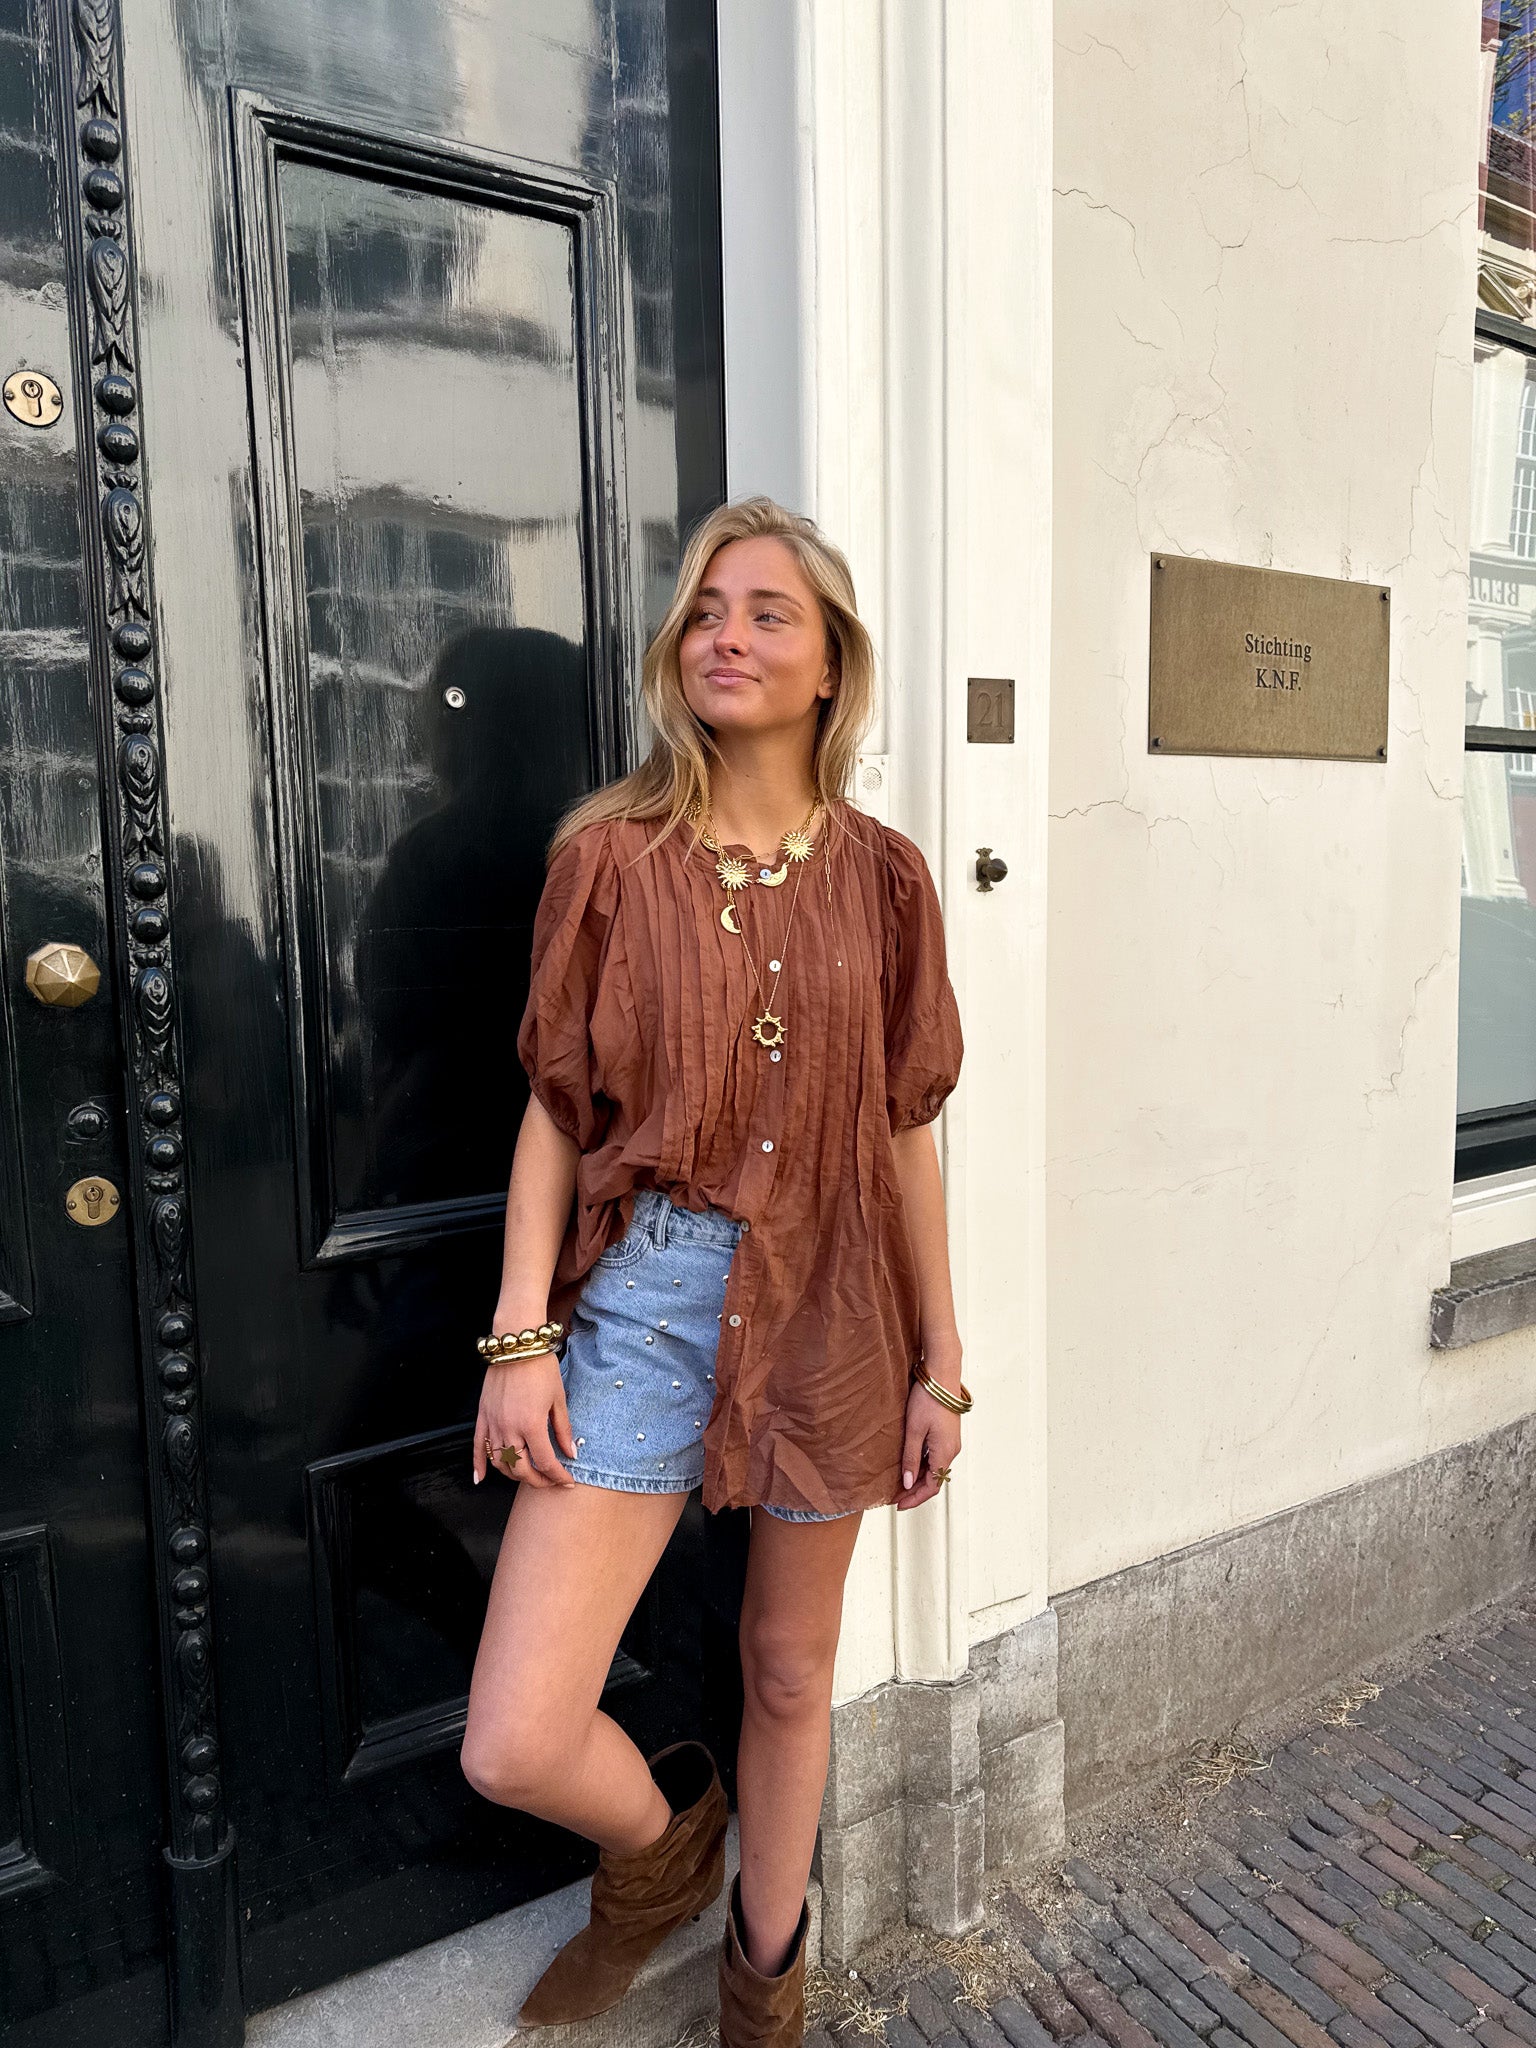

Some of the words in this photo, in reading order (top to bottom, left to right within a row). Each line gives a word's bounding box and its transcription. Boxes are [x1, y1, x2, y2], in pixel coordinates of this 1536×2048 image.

[1245, 633, 1312, 663] Stichting
[1255, 668, 1302, 691] K.N.F.
[976, 692, 1004, 728] 21
